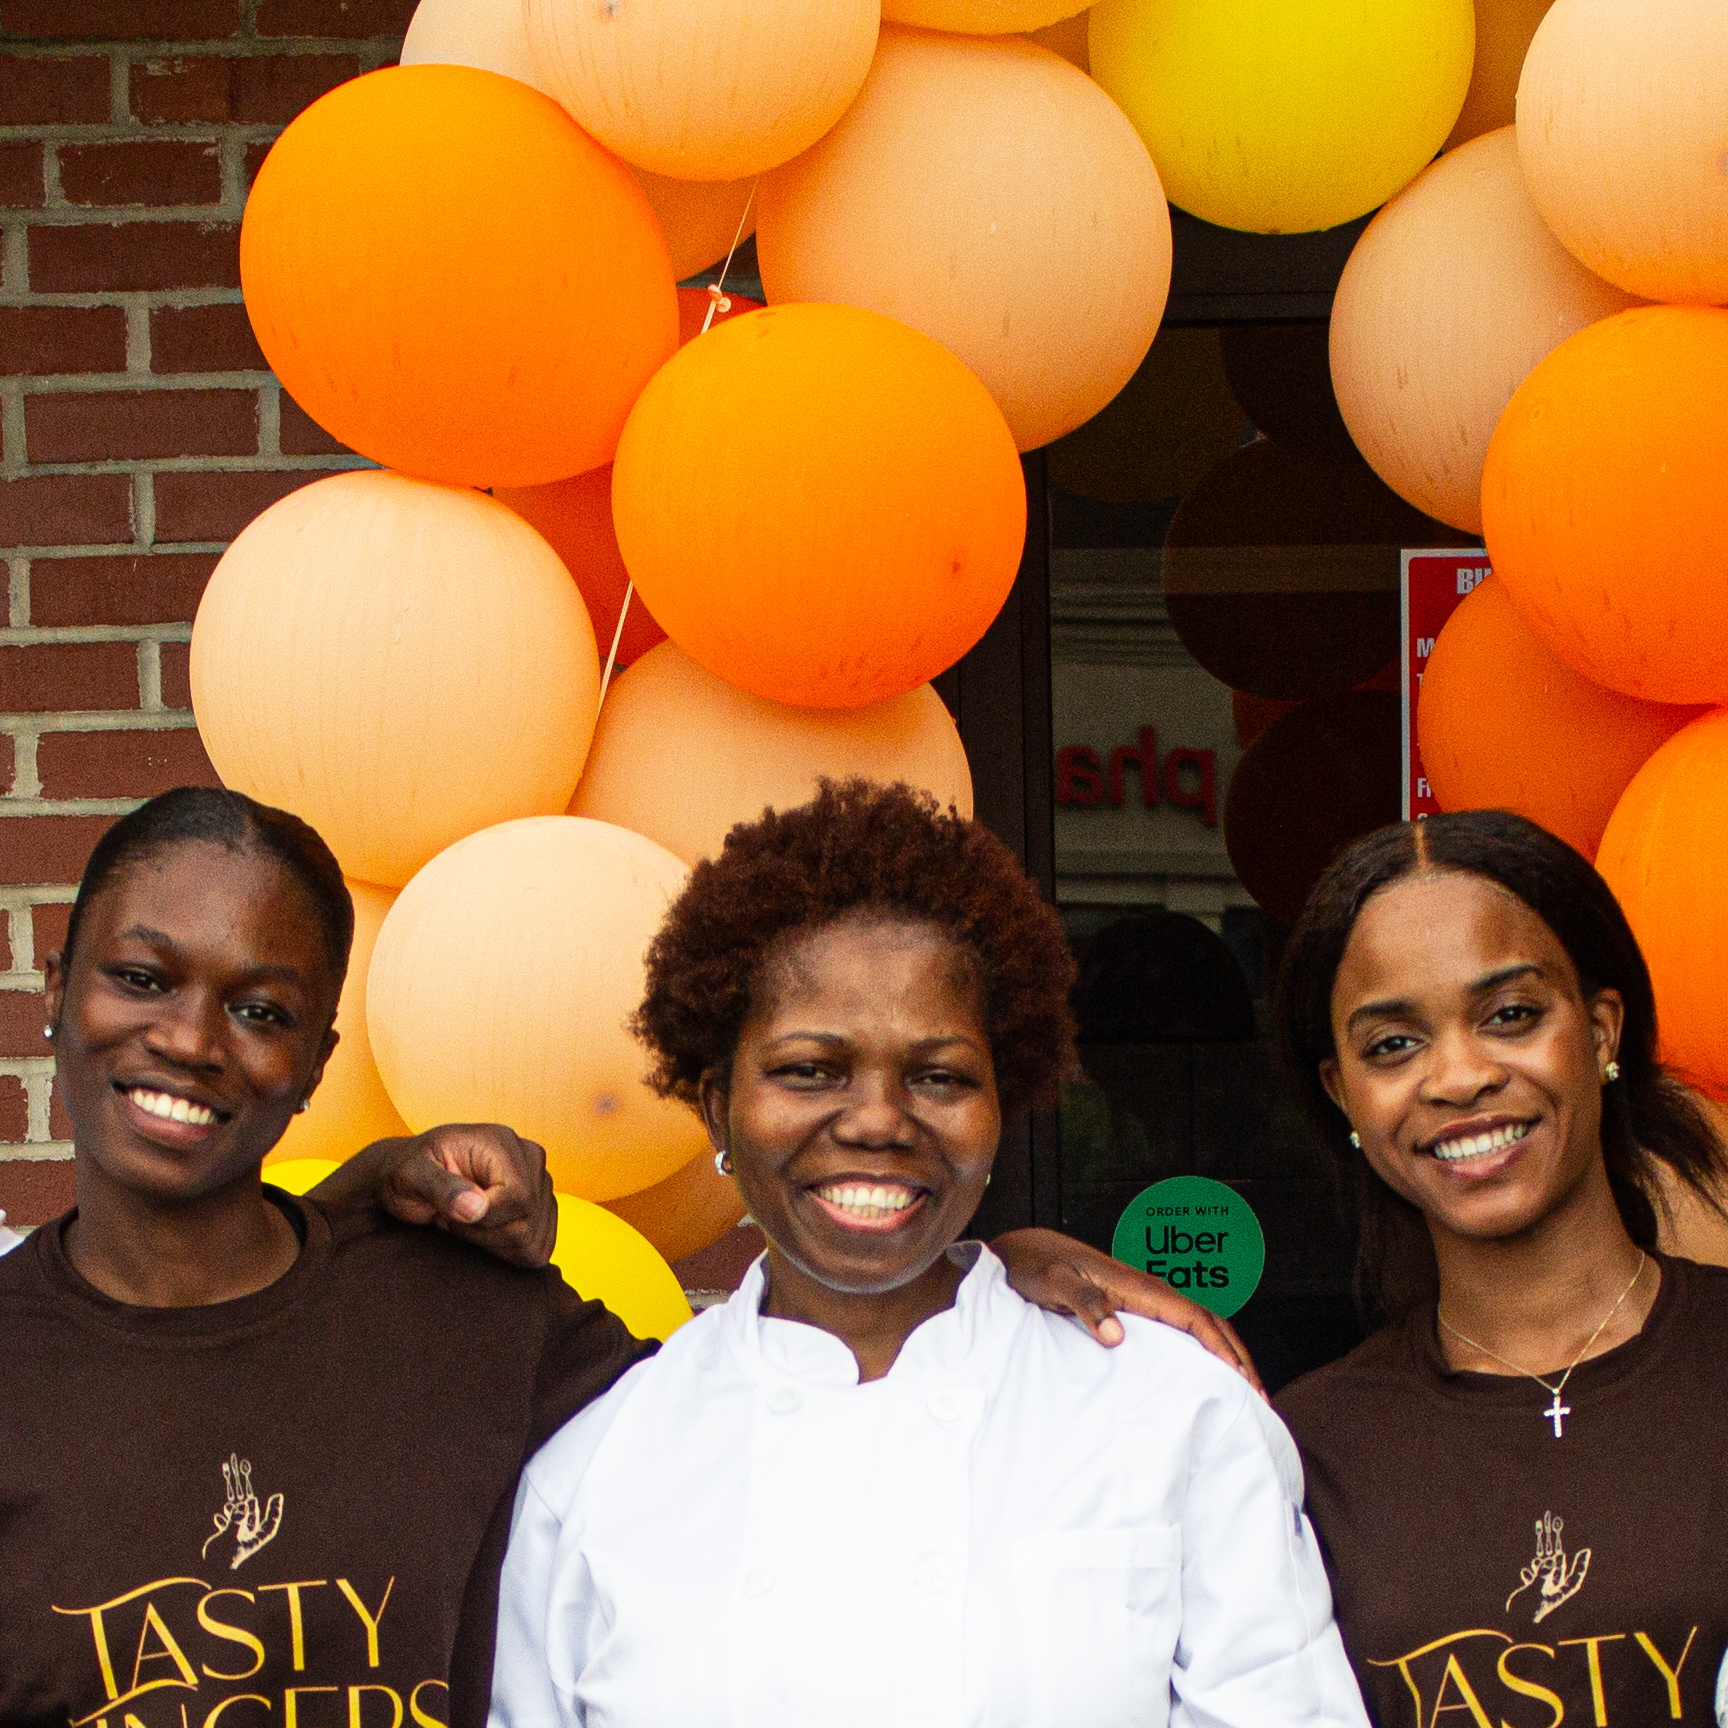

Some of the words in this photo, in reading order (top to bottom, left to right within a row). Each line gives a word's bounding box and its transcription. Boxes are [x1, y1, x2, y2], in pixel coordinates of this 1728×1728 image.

[1145, 1206, 1190, 1217] ORDER
[1194, 1205, 1229, 1216] WITH
[1145, 1225, 1229, 1255] Uber
[1146, 1260, 1230, 1289] Eats
[51, 1575, 395, 1702] TASTY
